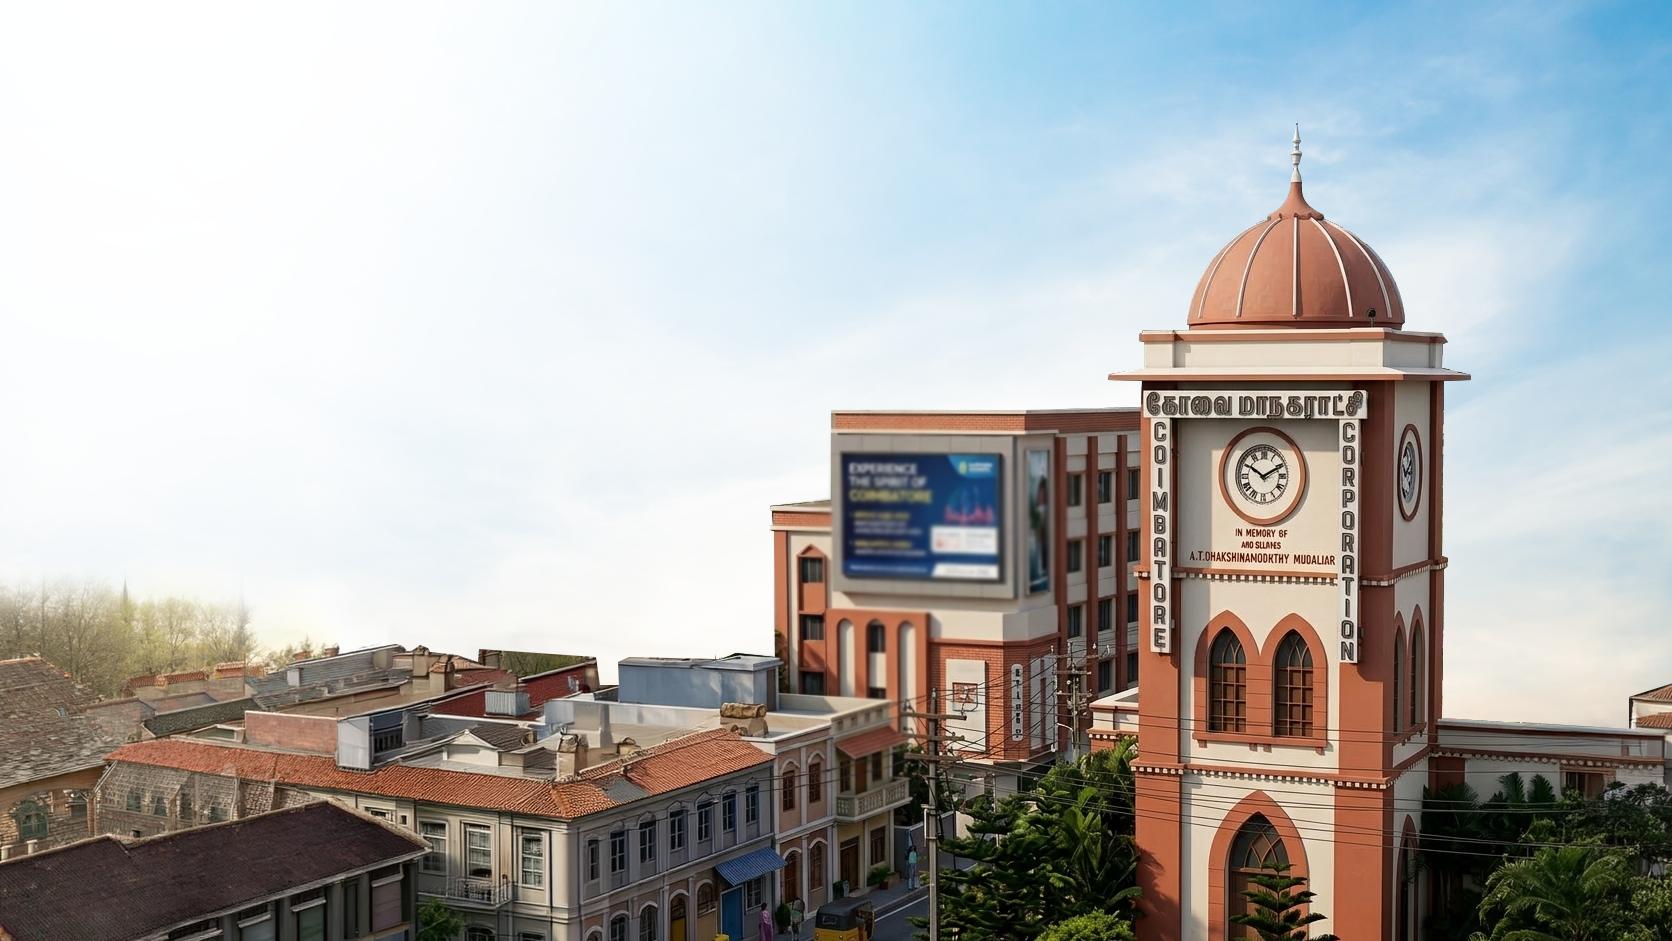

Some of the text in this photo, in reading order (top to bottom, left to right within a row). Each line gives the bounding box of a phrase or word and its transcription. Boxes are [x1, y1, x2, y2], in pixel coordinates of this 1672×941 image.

[1152, 422, 1169, 648] COIMBATORE
[1234, 528, 1243, 537] IN
[1245, 528, 1276, 538] MEMORY
[1341, 422, 1356, 662] CORPORATION
